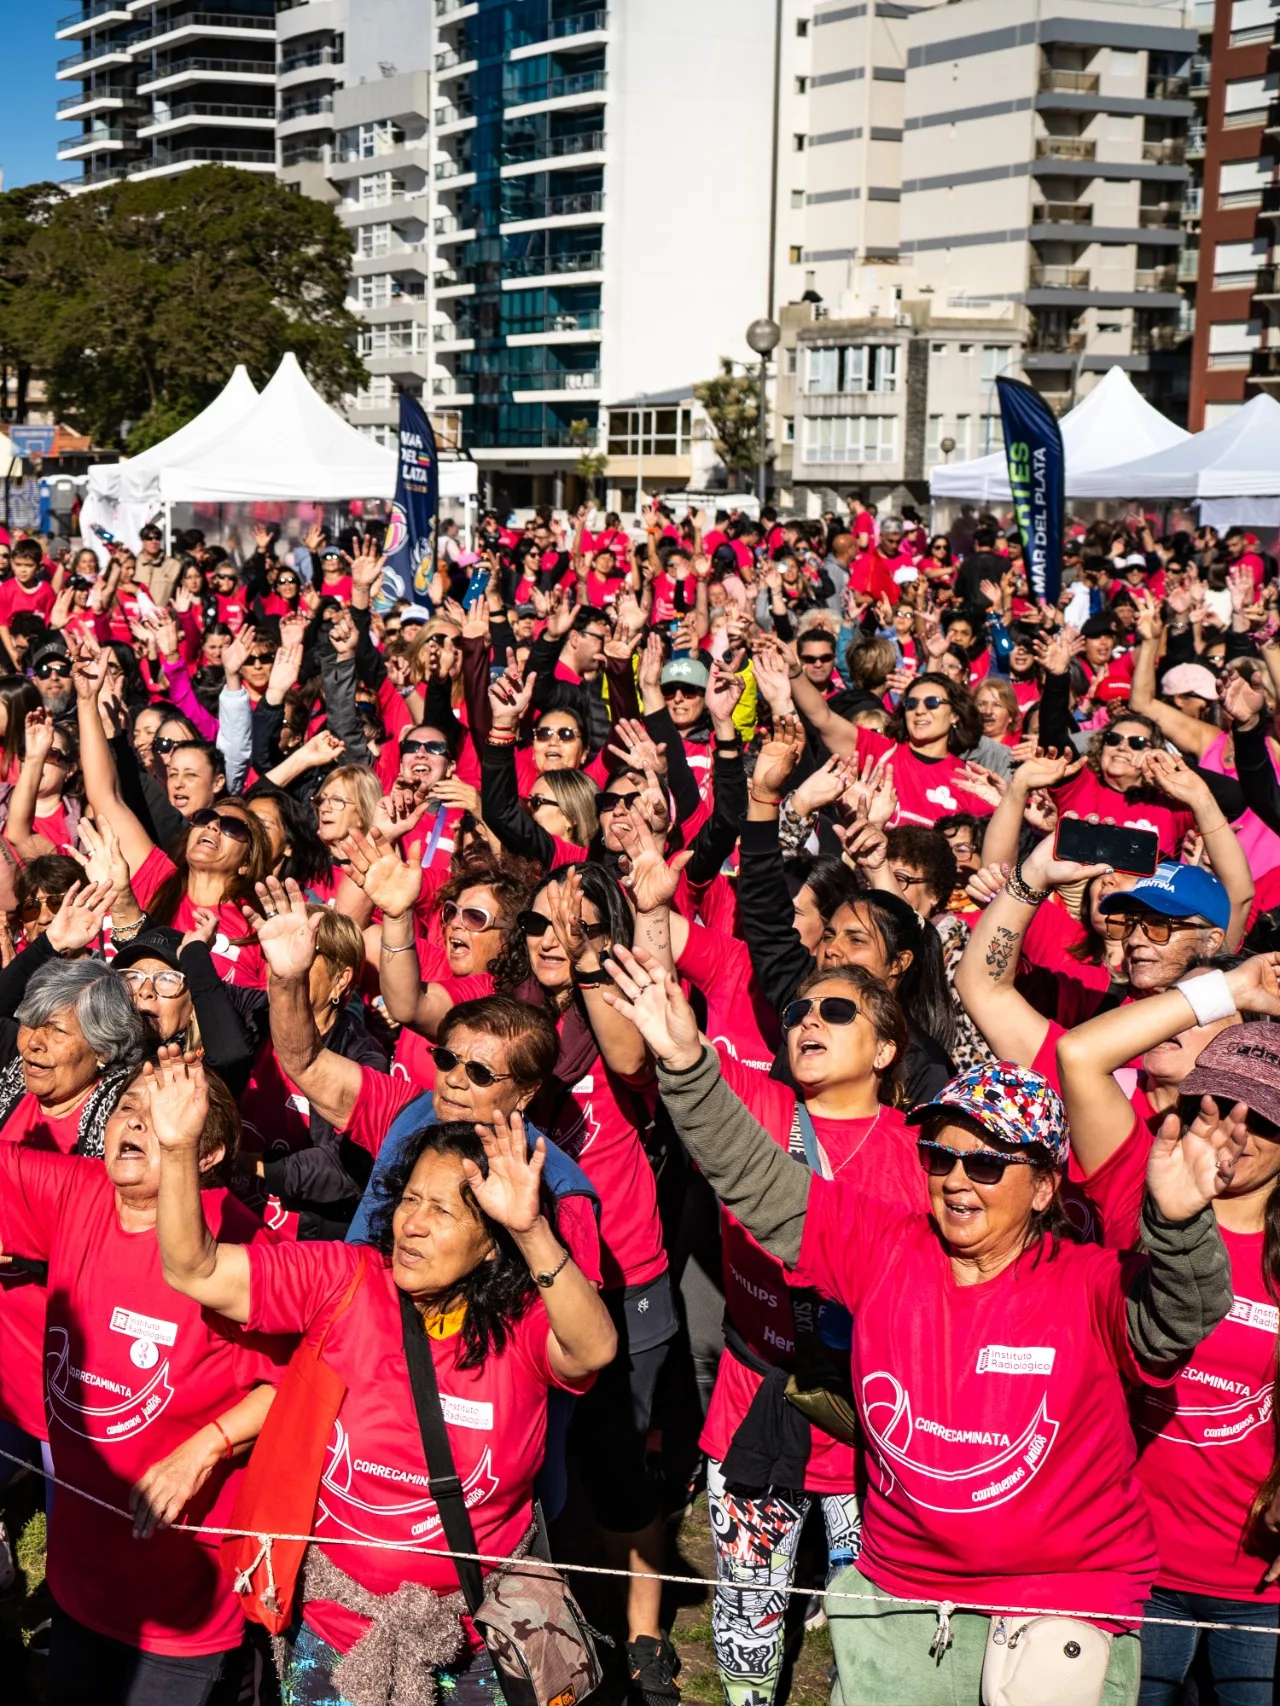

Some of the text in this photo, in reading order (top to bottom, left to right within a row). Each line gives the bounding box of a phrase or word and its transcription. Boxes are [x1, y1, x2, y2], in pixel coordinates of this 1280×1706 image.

[402, 464, 427, 483] LATA
[1031, 447, 1048, 594] MAR DEL PLATA
[130, 1316, 161, 1331] Instituto
[763, 1325, 795, 1353] Her
[992, 1350, 1032, 1360] Instituto
[992, 1359, 1051, 1372] Radiológico
[1181, 1367, 1251, 1397] ECAMINATA
[107, 1415, 141, 1435] caminemos
[915, 1417, 1011, 1447] CORRECAMINATA
[1204, 1413, 1255, 1438] caminemos
[353, 1459, 429, 1488] CORRECAMIN
[971, 1433, 1047, 1502] caminemos juntos
[411, 1487, 485, 1537] camine untos
